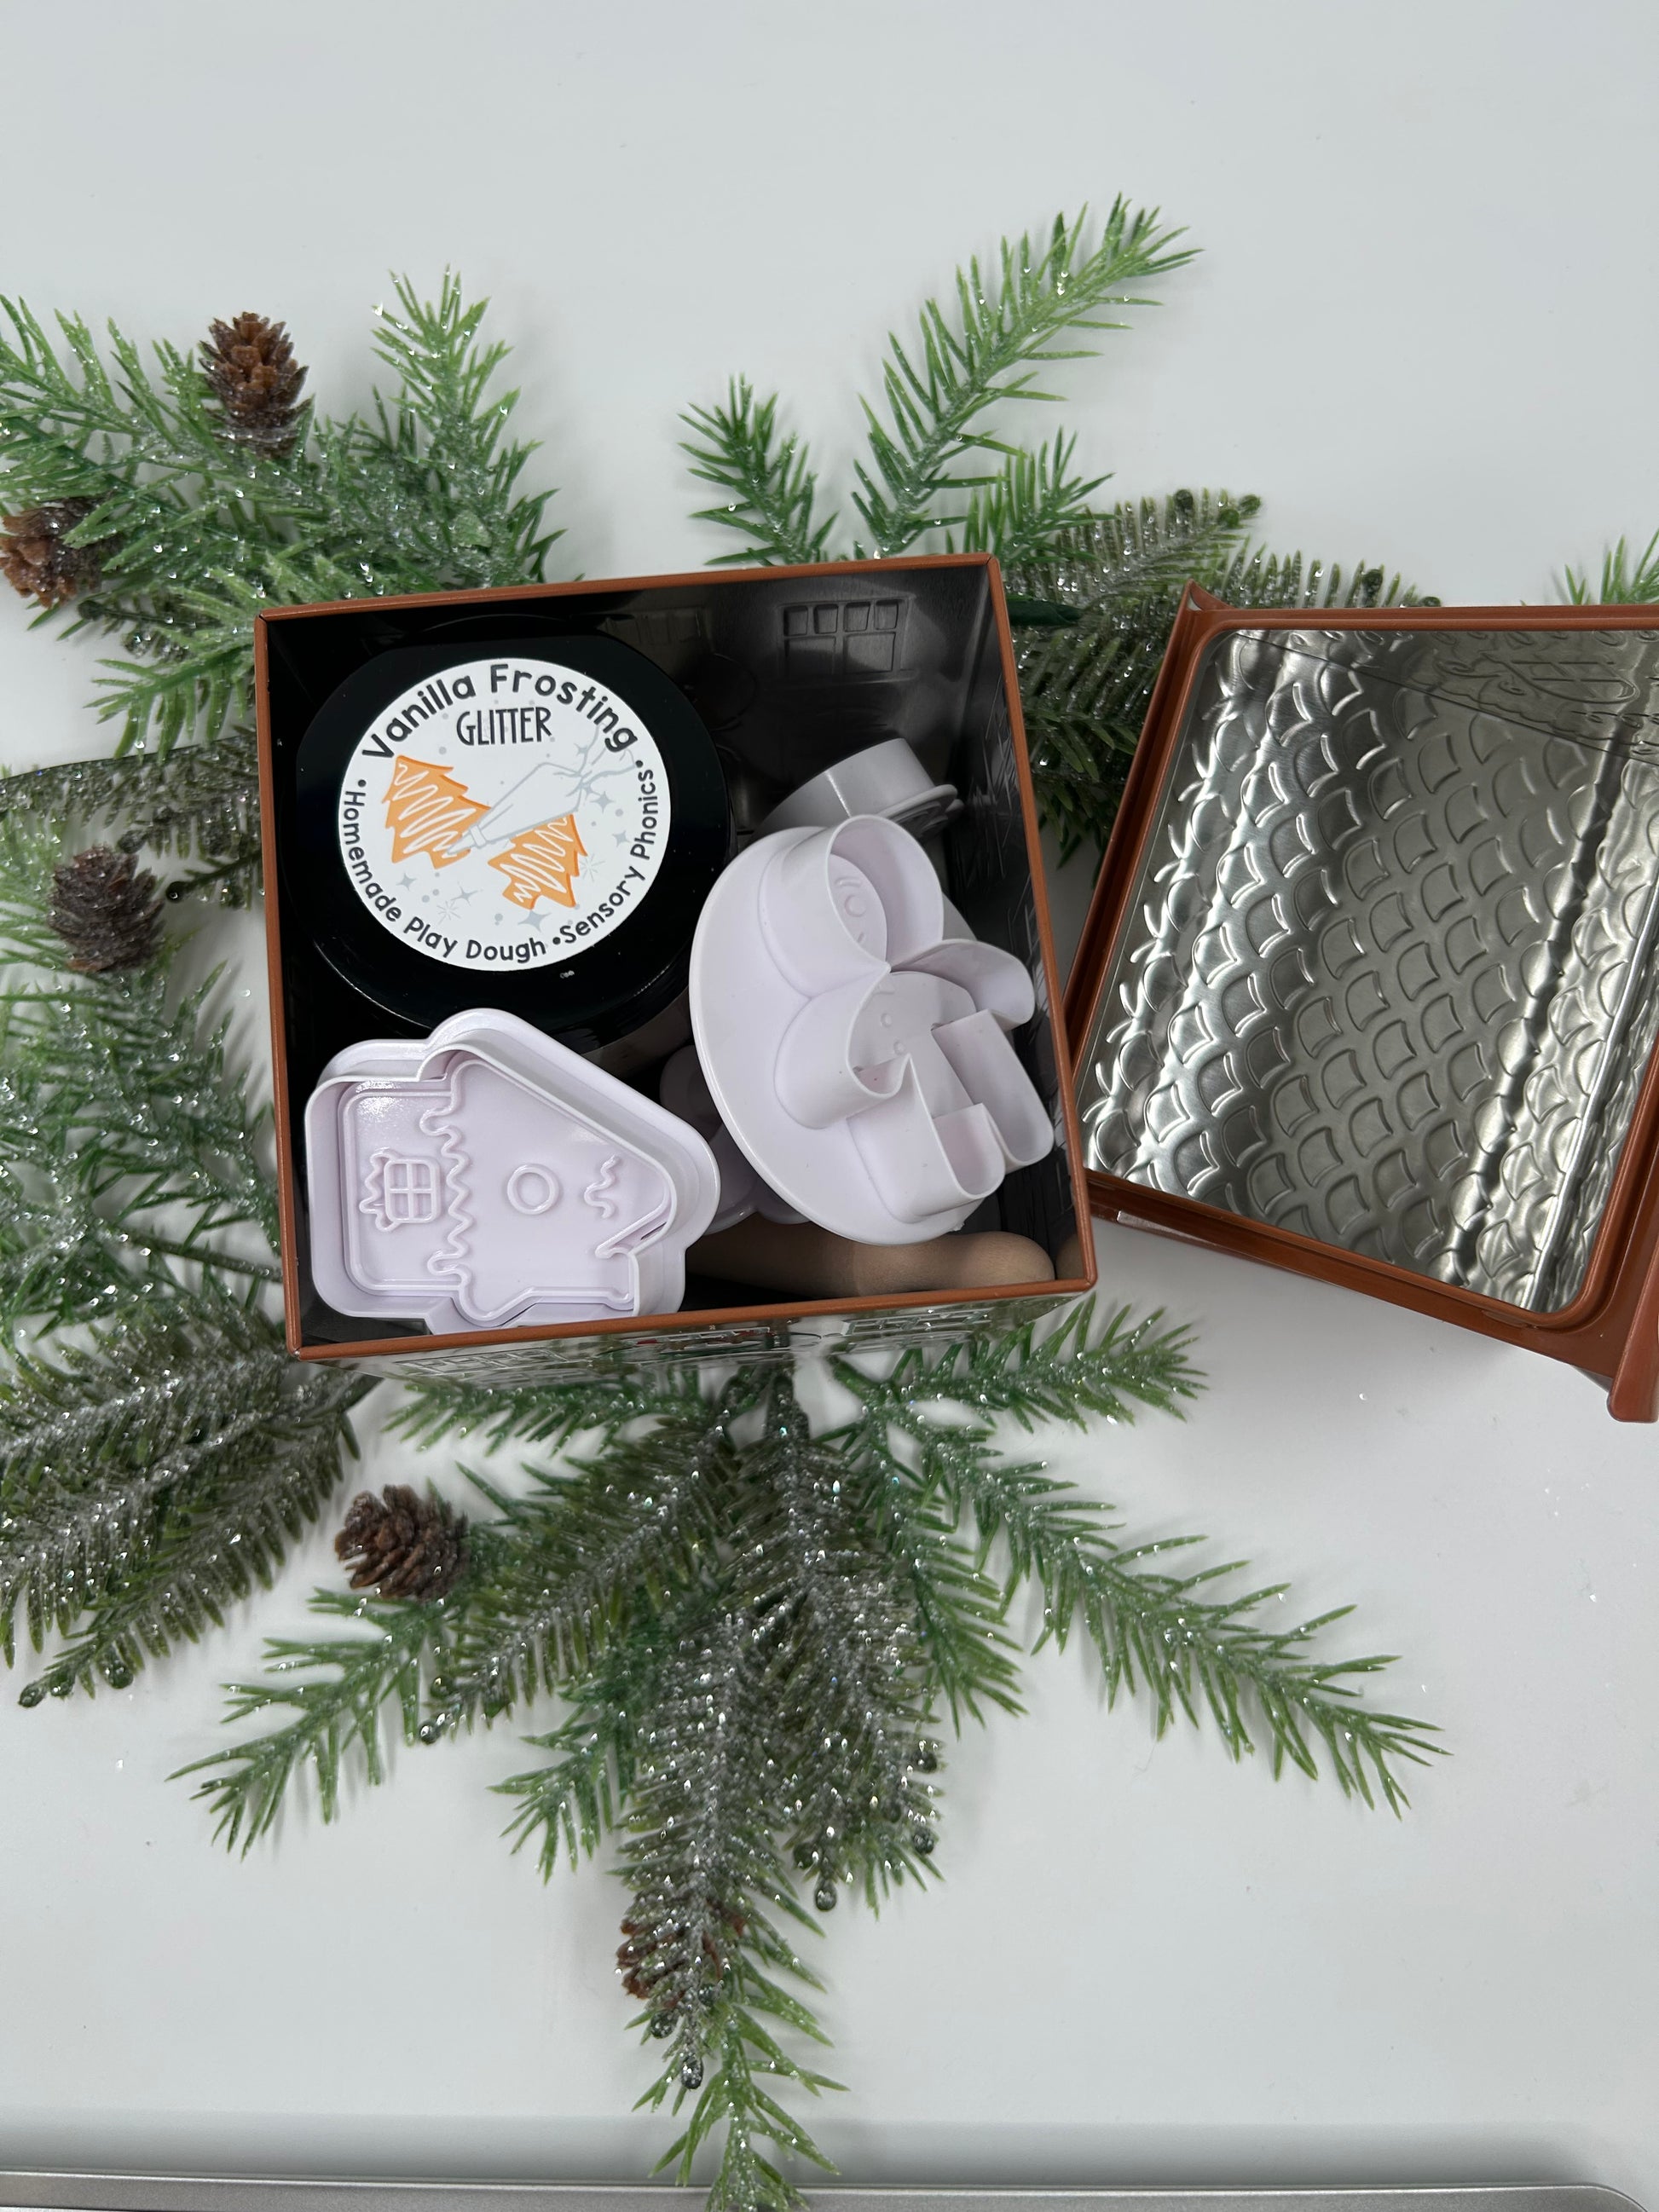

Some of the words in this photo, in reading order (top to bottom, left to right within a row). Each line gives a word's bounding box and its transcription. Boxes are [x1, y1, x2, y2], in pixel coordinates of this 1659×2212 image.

[361, 675, 477, 758] Vanilla
[490, 663, 639, 753] Frosting
[456, 706, 552, 746] GLITTER
[344, 791, 402, 922] Homemade
[403, 916, 458, 958] Play
[465, 937, 546, 964] Dough
[559, 865, 645, 944] Sensory
[630, 769, 659, 860] Phonics
